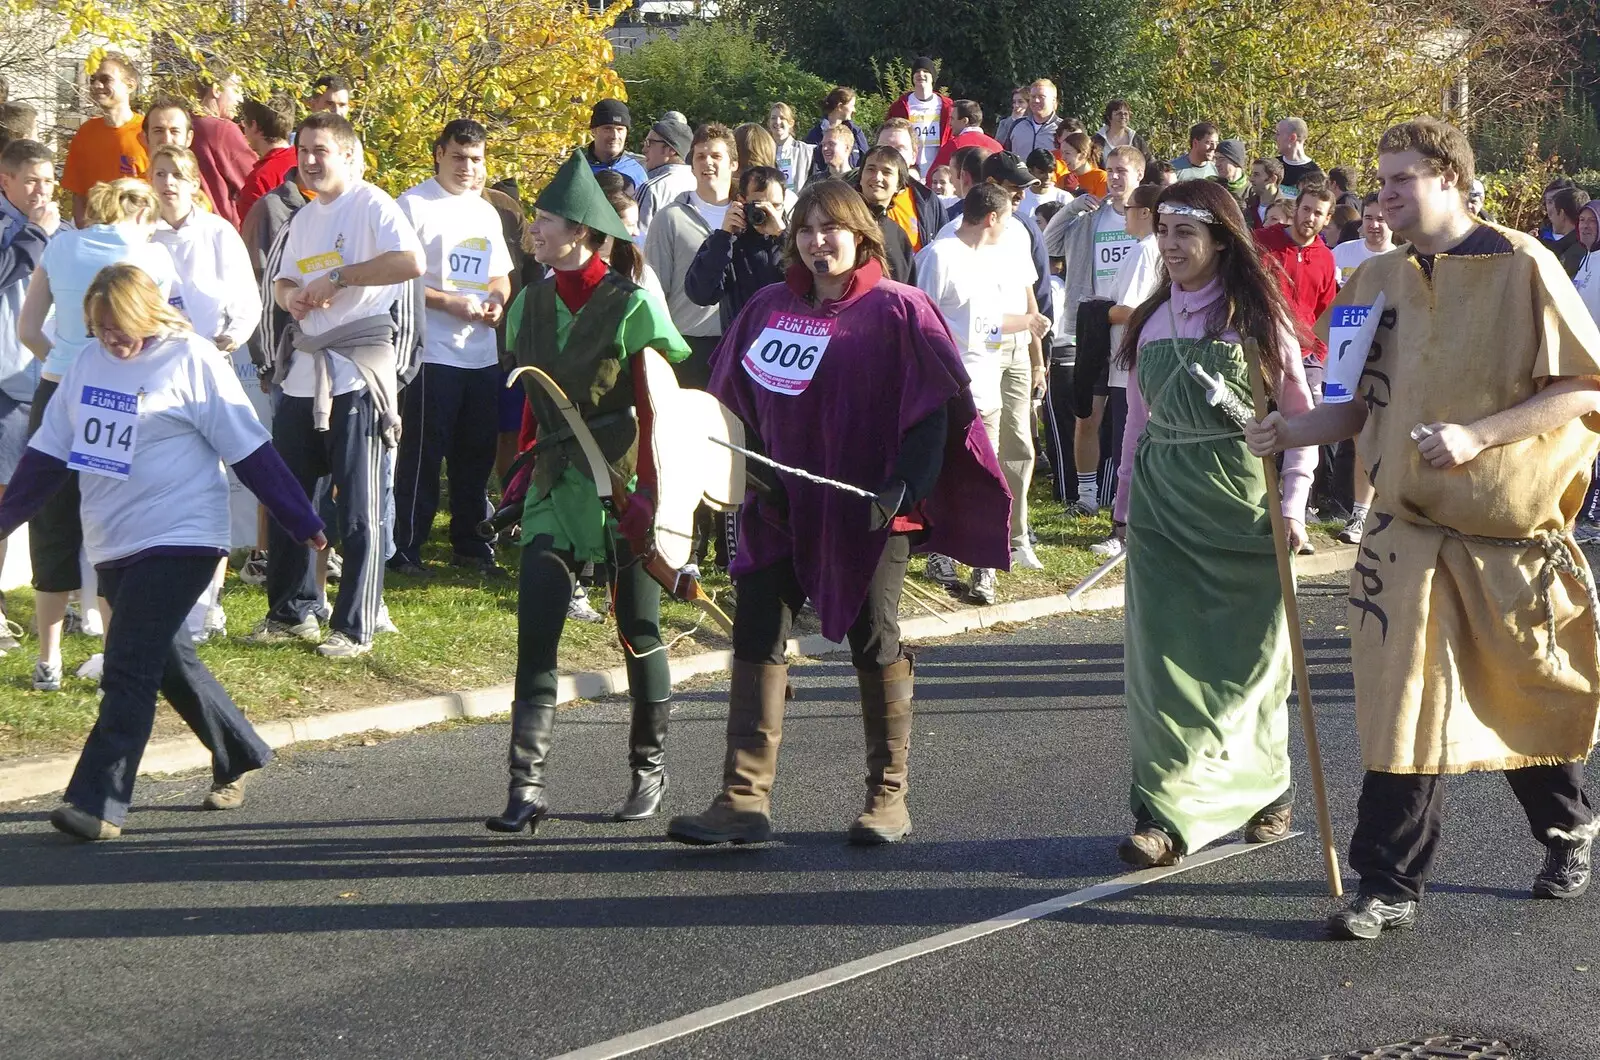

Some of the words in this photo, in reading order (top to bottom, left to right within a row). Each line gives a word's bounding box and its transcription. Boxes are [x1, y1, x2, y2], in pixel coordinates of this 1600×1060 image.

[449, 253, 482, 275] 077
[775, 320, 802, 333] FUN
[804, 325, 829, 336] RUN
[780, 315, 831, 327] CAMBRIDGE
[760, 339, 819, 371] 006
[90, 395, 115, 409] FUN
[84, 417, 133, 452] 014
